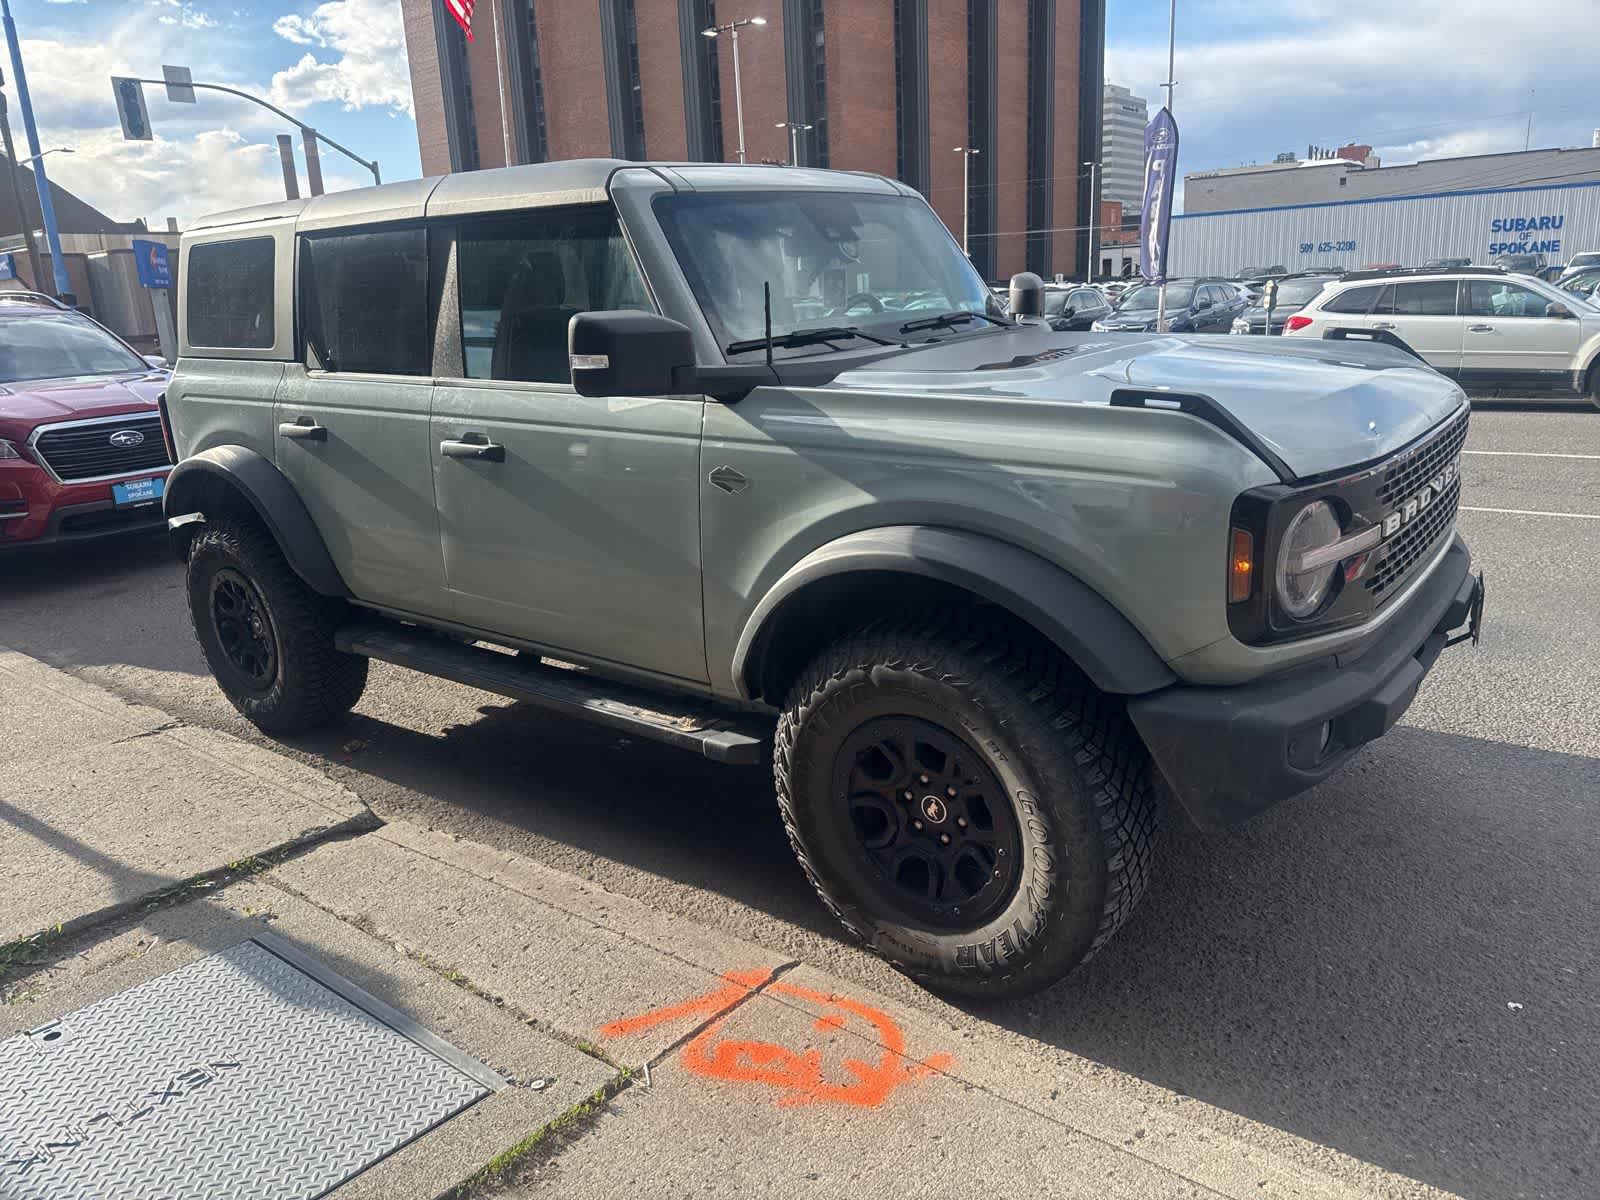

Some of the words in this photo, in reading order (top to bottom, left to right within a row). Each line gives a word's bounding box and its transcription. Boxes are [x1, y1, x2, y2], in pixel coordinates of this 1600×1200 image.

[1492, 215, 1564, 233] SUBARU
[1519, 231, 1532, 241] OF
[1299, 243, 1314, 253] 509
[1489, 240, 1561, 255] SPOKANE
[125, 480, 153, 490] SUBARU
